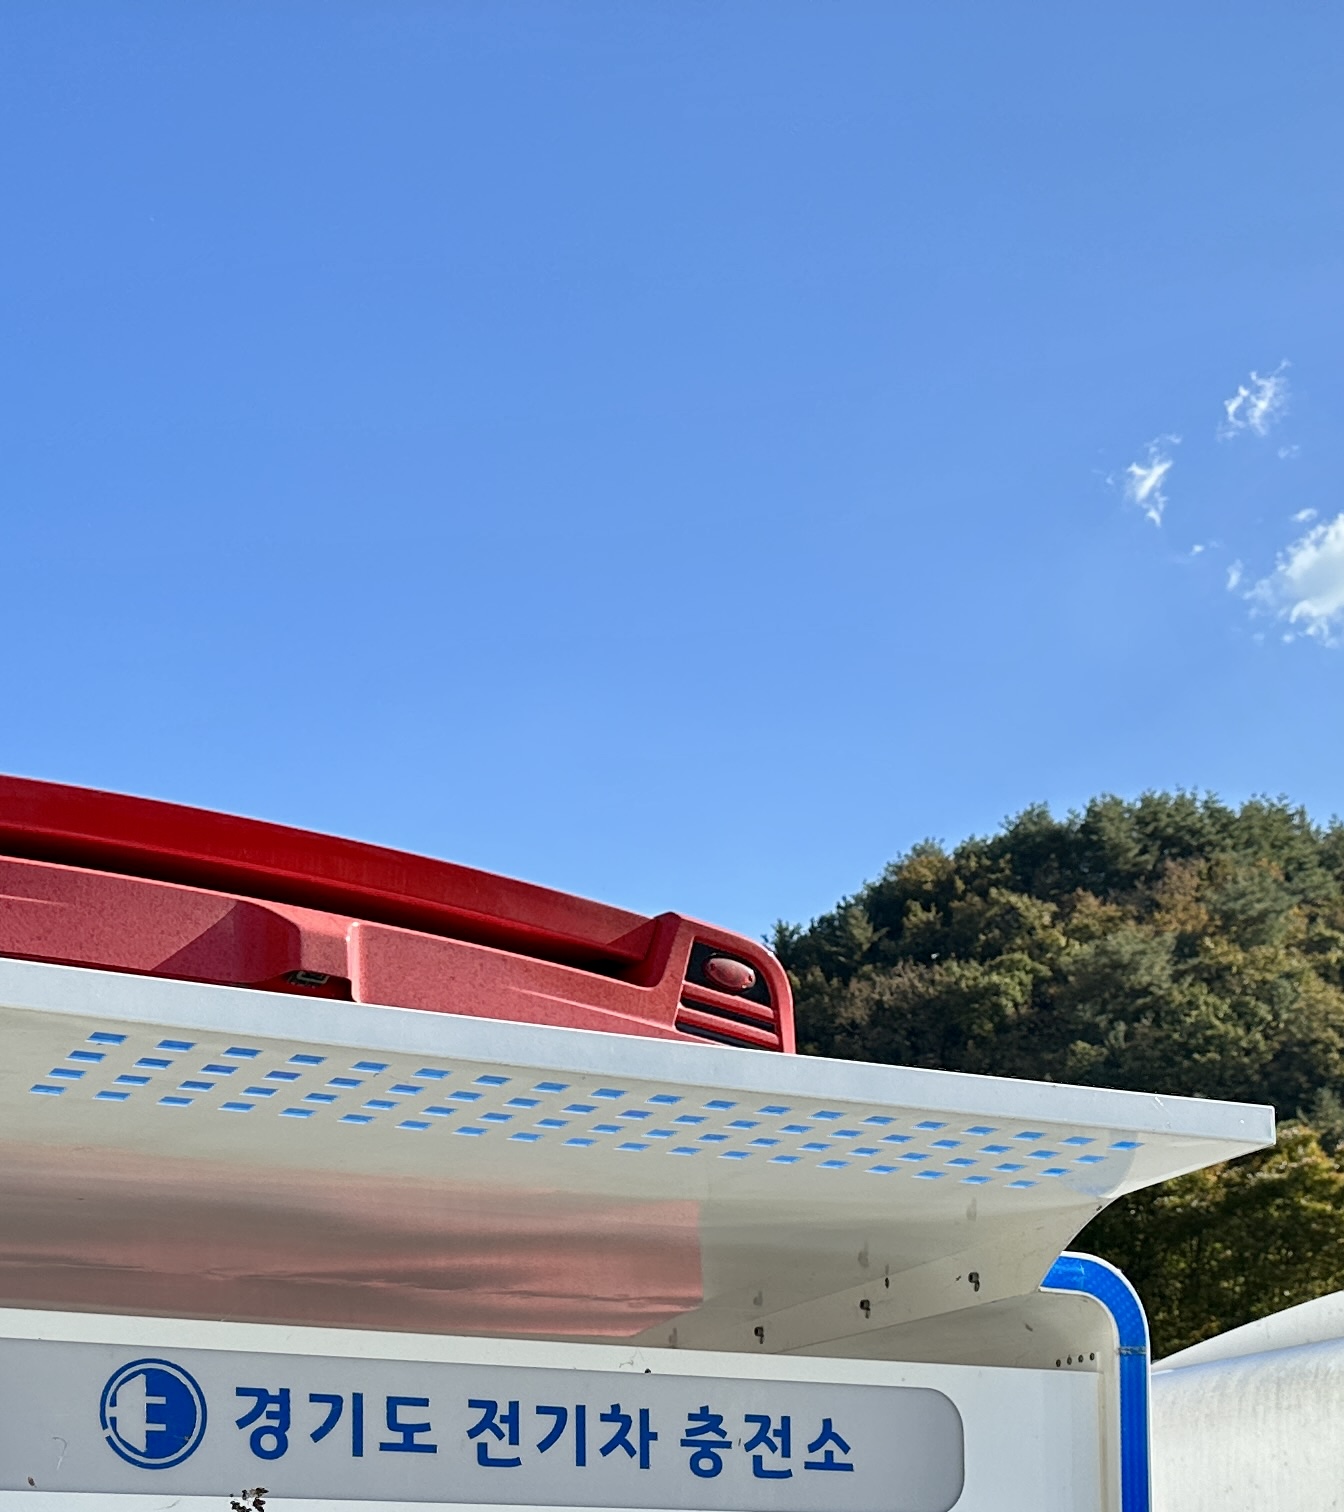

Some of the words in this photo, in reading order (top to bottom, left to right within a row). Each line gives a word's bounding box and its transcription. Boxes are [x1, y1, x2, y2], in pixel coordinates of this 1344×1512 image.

[234, 1387, 438, 1461] 경기도
[466, 1399, 659, 1470] 전기차
[680, 1406, 856, 1480] 충전소
